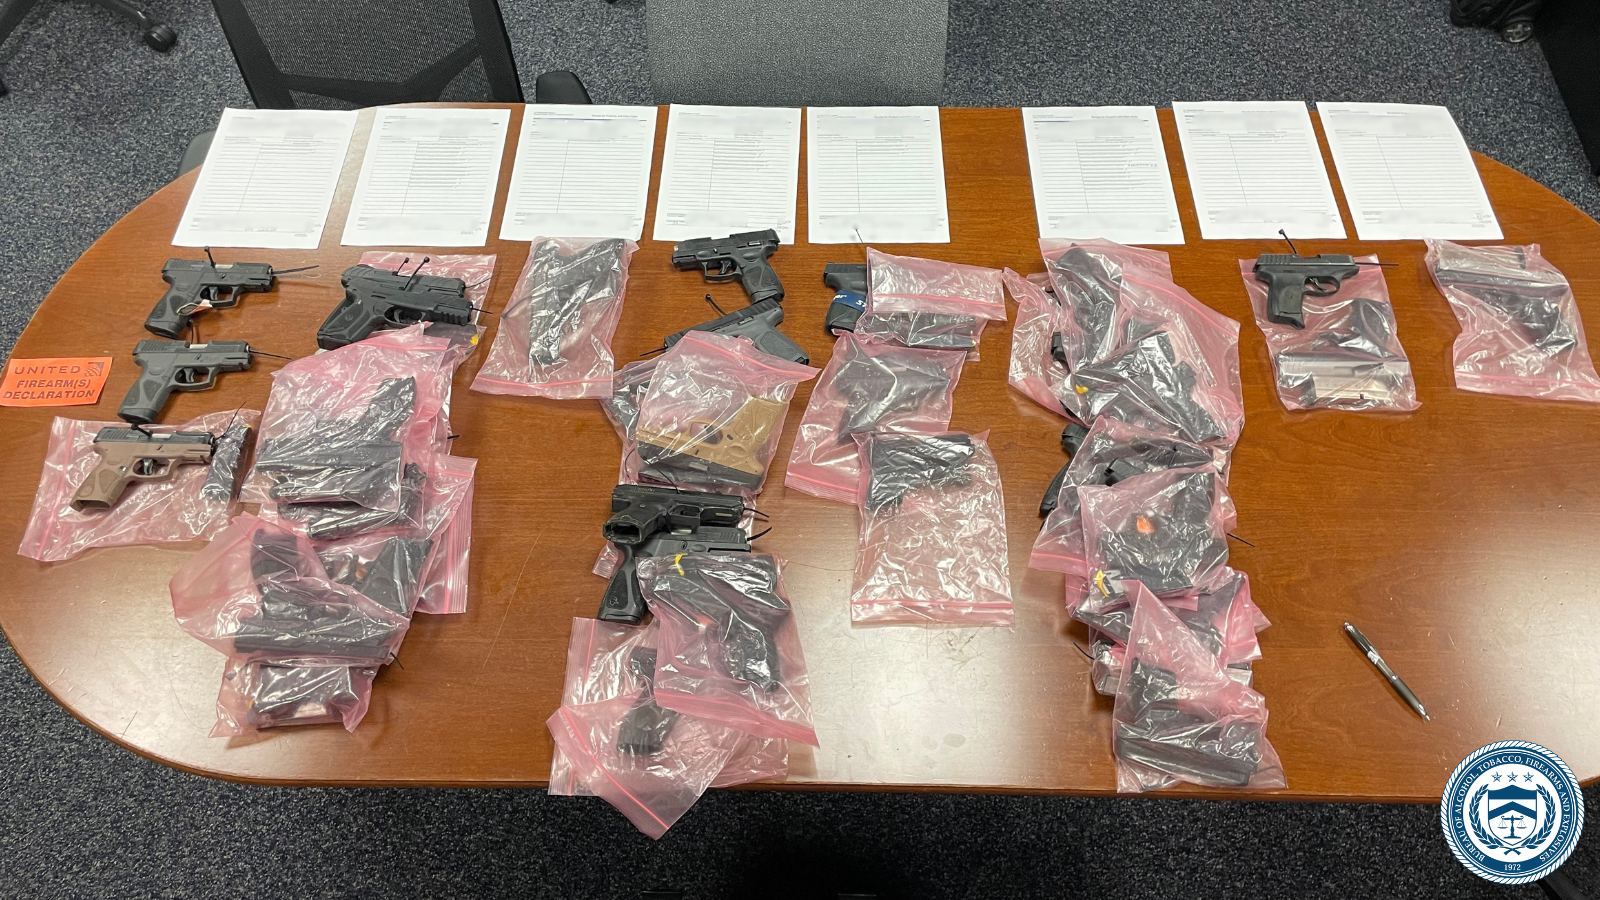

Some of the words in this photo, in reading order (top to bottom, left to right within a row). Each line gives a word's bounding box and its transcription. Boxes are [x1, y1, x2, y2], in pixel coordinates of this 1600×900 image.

[14, 366, 81, 375] UNITED
[17, 379, 91, 389] FIREARM(S)
[2, 389, 95, 400] DECLARATION
